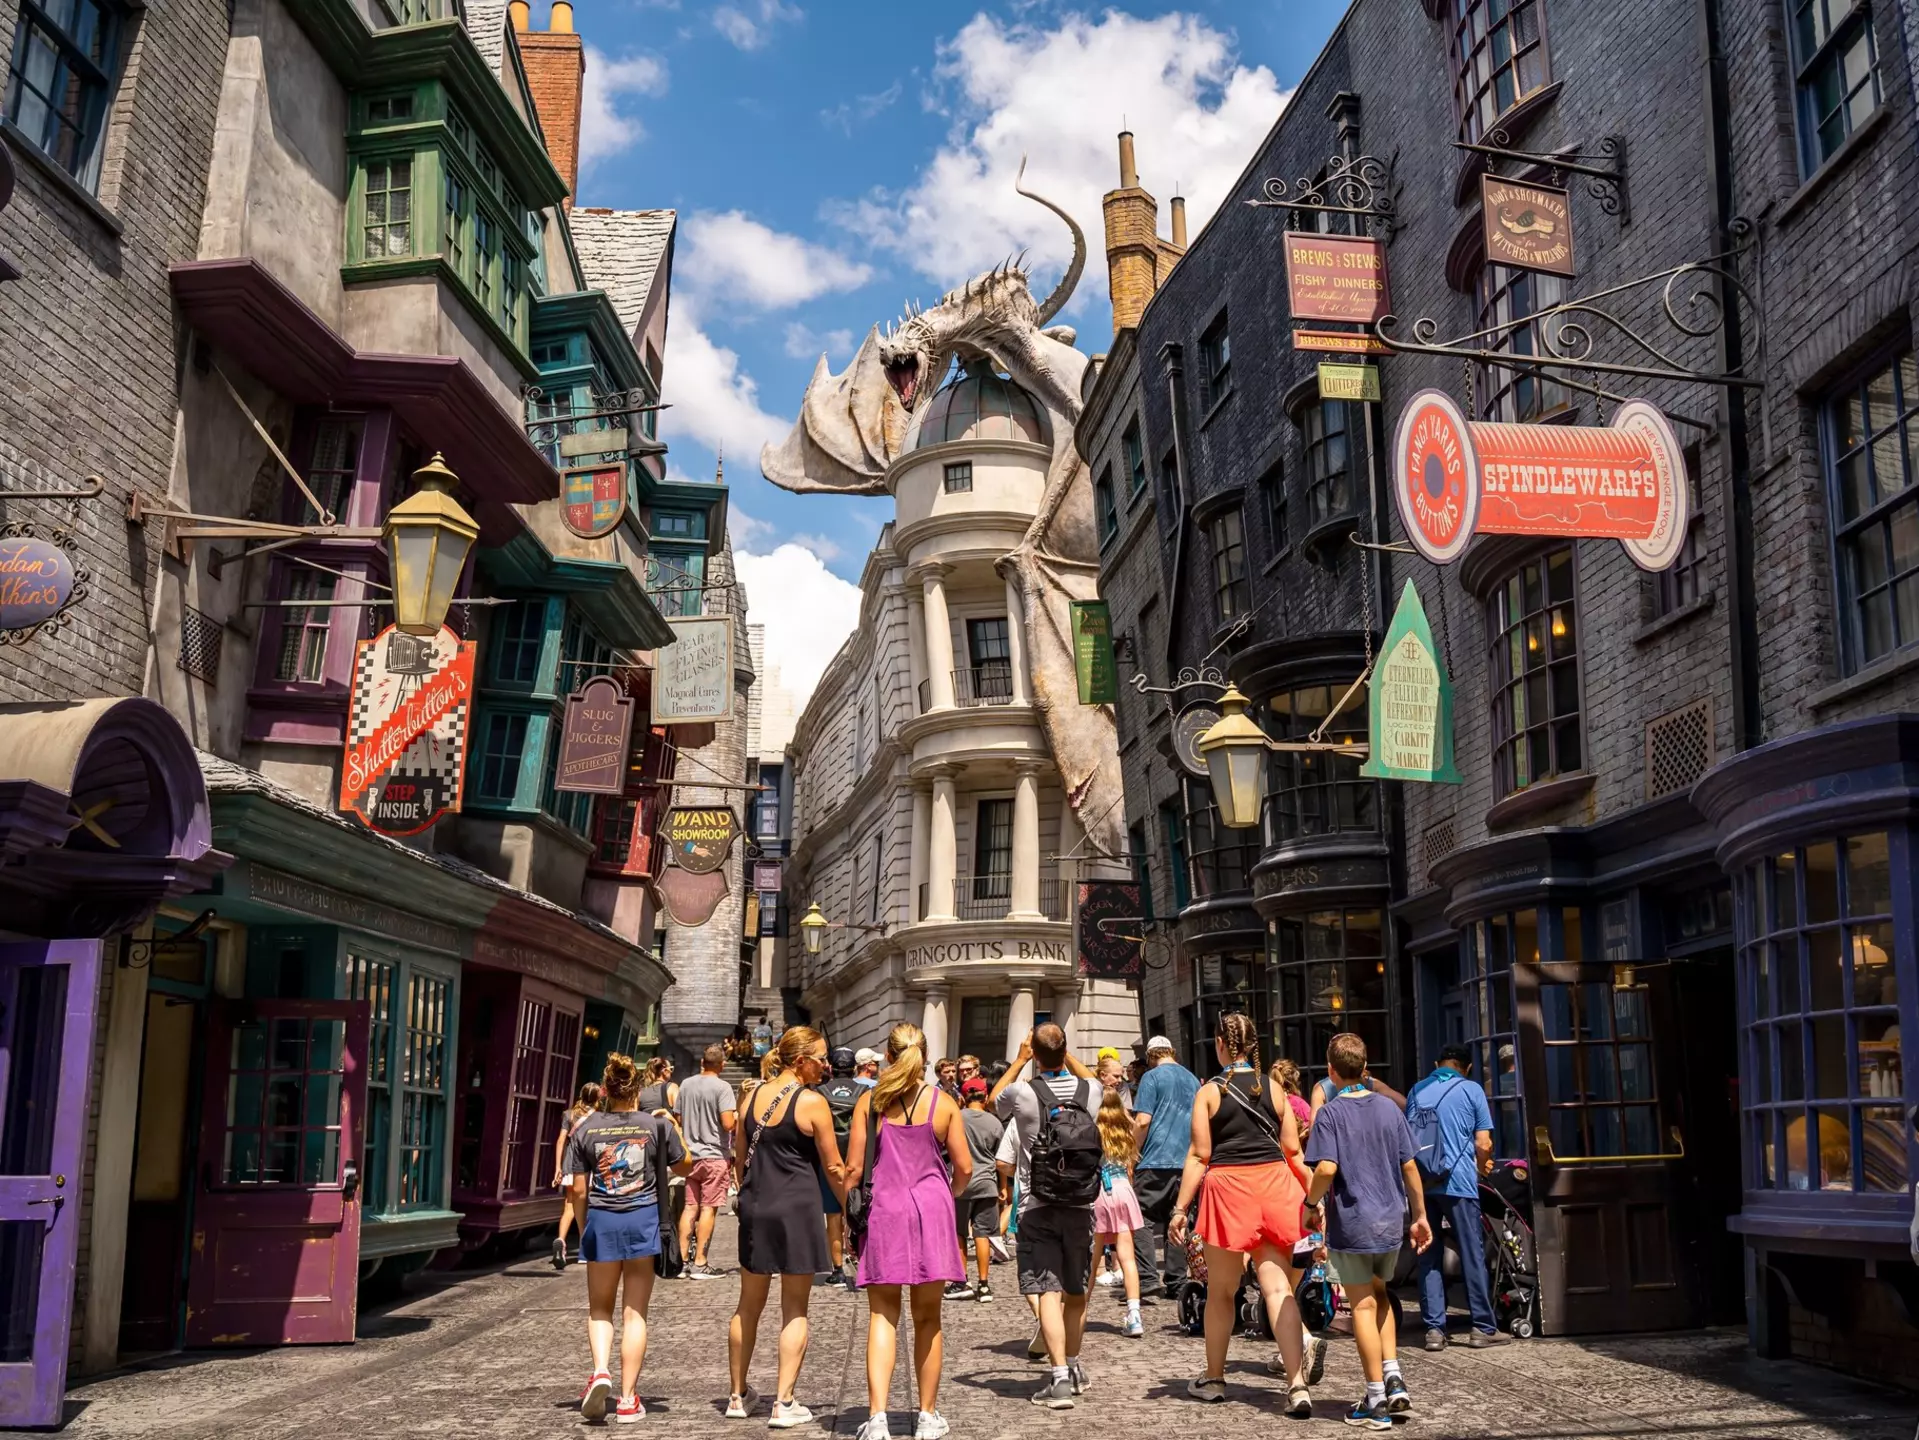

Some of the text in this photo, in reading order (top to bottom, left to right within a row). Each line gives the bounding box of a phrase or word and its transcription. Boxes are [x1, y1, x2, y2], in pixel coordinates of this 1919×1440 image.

[1488, 188, 1508, 206] BOOT
[1514, 188, 1567, 219] SHOEMAKER
[1491, 231, 1529, 262] WITCHES
[1534, 242, 1569, 264] WIZARDS
[1293, 249, 1333, 267] BREWS
[1343, 252, 1382, 270] STEWS
[1295, 274, 1383, 290] FISHY DINNERS
[1300, 335, 1384, 350] BREWS STEW
[1411, 414, 1461, 475] FANCY YARNS
[1484, 463, 1656, 498] SPINDLEWARPS
[1642, 425, 1672, 540] NEVER-TANGLE WOOL
[1416, 492, 1459, 538] BUTTONS
[1394, 683, 1429, 703] ELIXIR OF
[582, 709, 614, 721] SLUG
[347, 670, 467, 792] Shutterbutton's
[591, 721, 603, 732] &
[1387, 723, 1425, 731] LOCATED
[569, 733, 620, 746] JIGGERS
[1395, 731, 1430, 749] CARKITT
[563, 754, 619, 775] APOTHECARY
[1396, 752, 1430, 769] MARKET
[385, 785, 416, 800] STEP
[378, 803, 420, 819] INSIDE
[672, 811, 730, 826] WAND
[672, 829, 729, 840] SHOWROOM
[907, 942, 1067, 968] GRINGOTTS BANK
